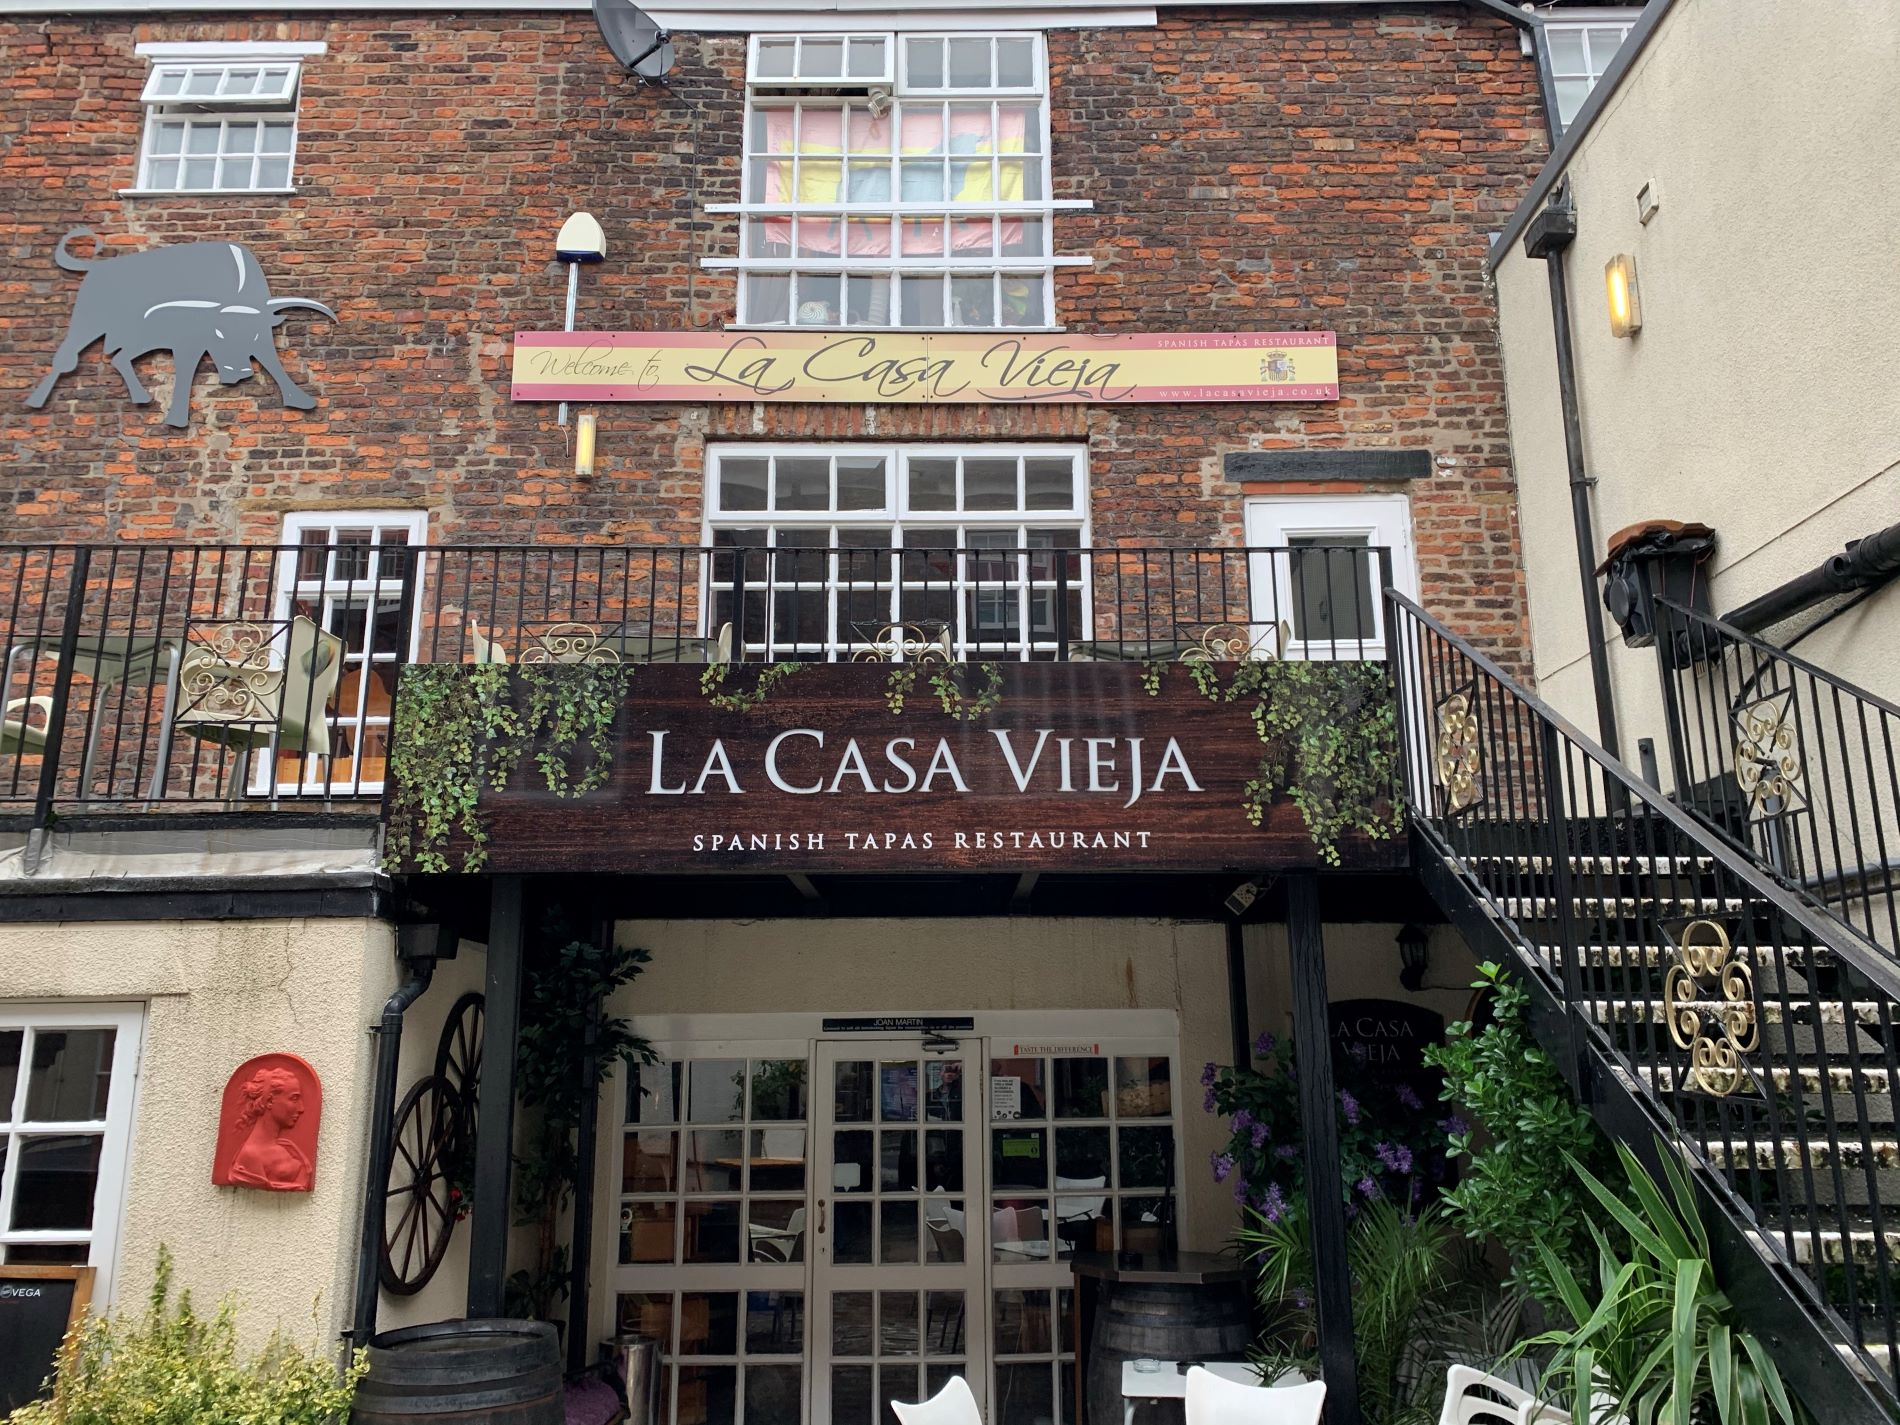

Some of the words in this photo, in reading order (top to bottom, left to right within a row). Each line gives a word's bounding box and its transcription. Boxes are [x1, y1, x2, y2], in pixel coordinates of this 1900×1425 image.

[1157, 339, 1208, 348] SPANISH
[1214, 339, 1248, 347] TAPAS
[1254, 337, 1330, 346] RESTAURANT
[531, 340, 634, 376] Welcome
[637, 350, 660, 391] to
[684, 336, 795, 396] La
[803, 337, 971, 397] Casa
[976, 340, 1137, 401] Vieja
[1159, 386, 1332, 399] www.lacasavieja.co.uk
[692, 833, 825, 852] SPANISH
[844, 832, 934, 850] TAPAS
[953, 830, 1152, 850] RESTAURANT
[873, 1018, 893, 1026] JOAN
[895, 1018, 923, 1026] MARTIN
[12, 1288, 41, 1297] VEGA
